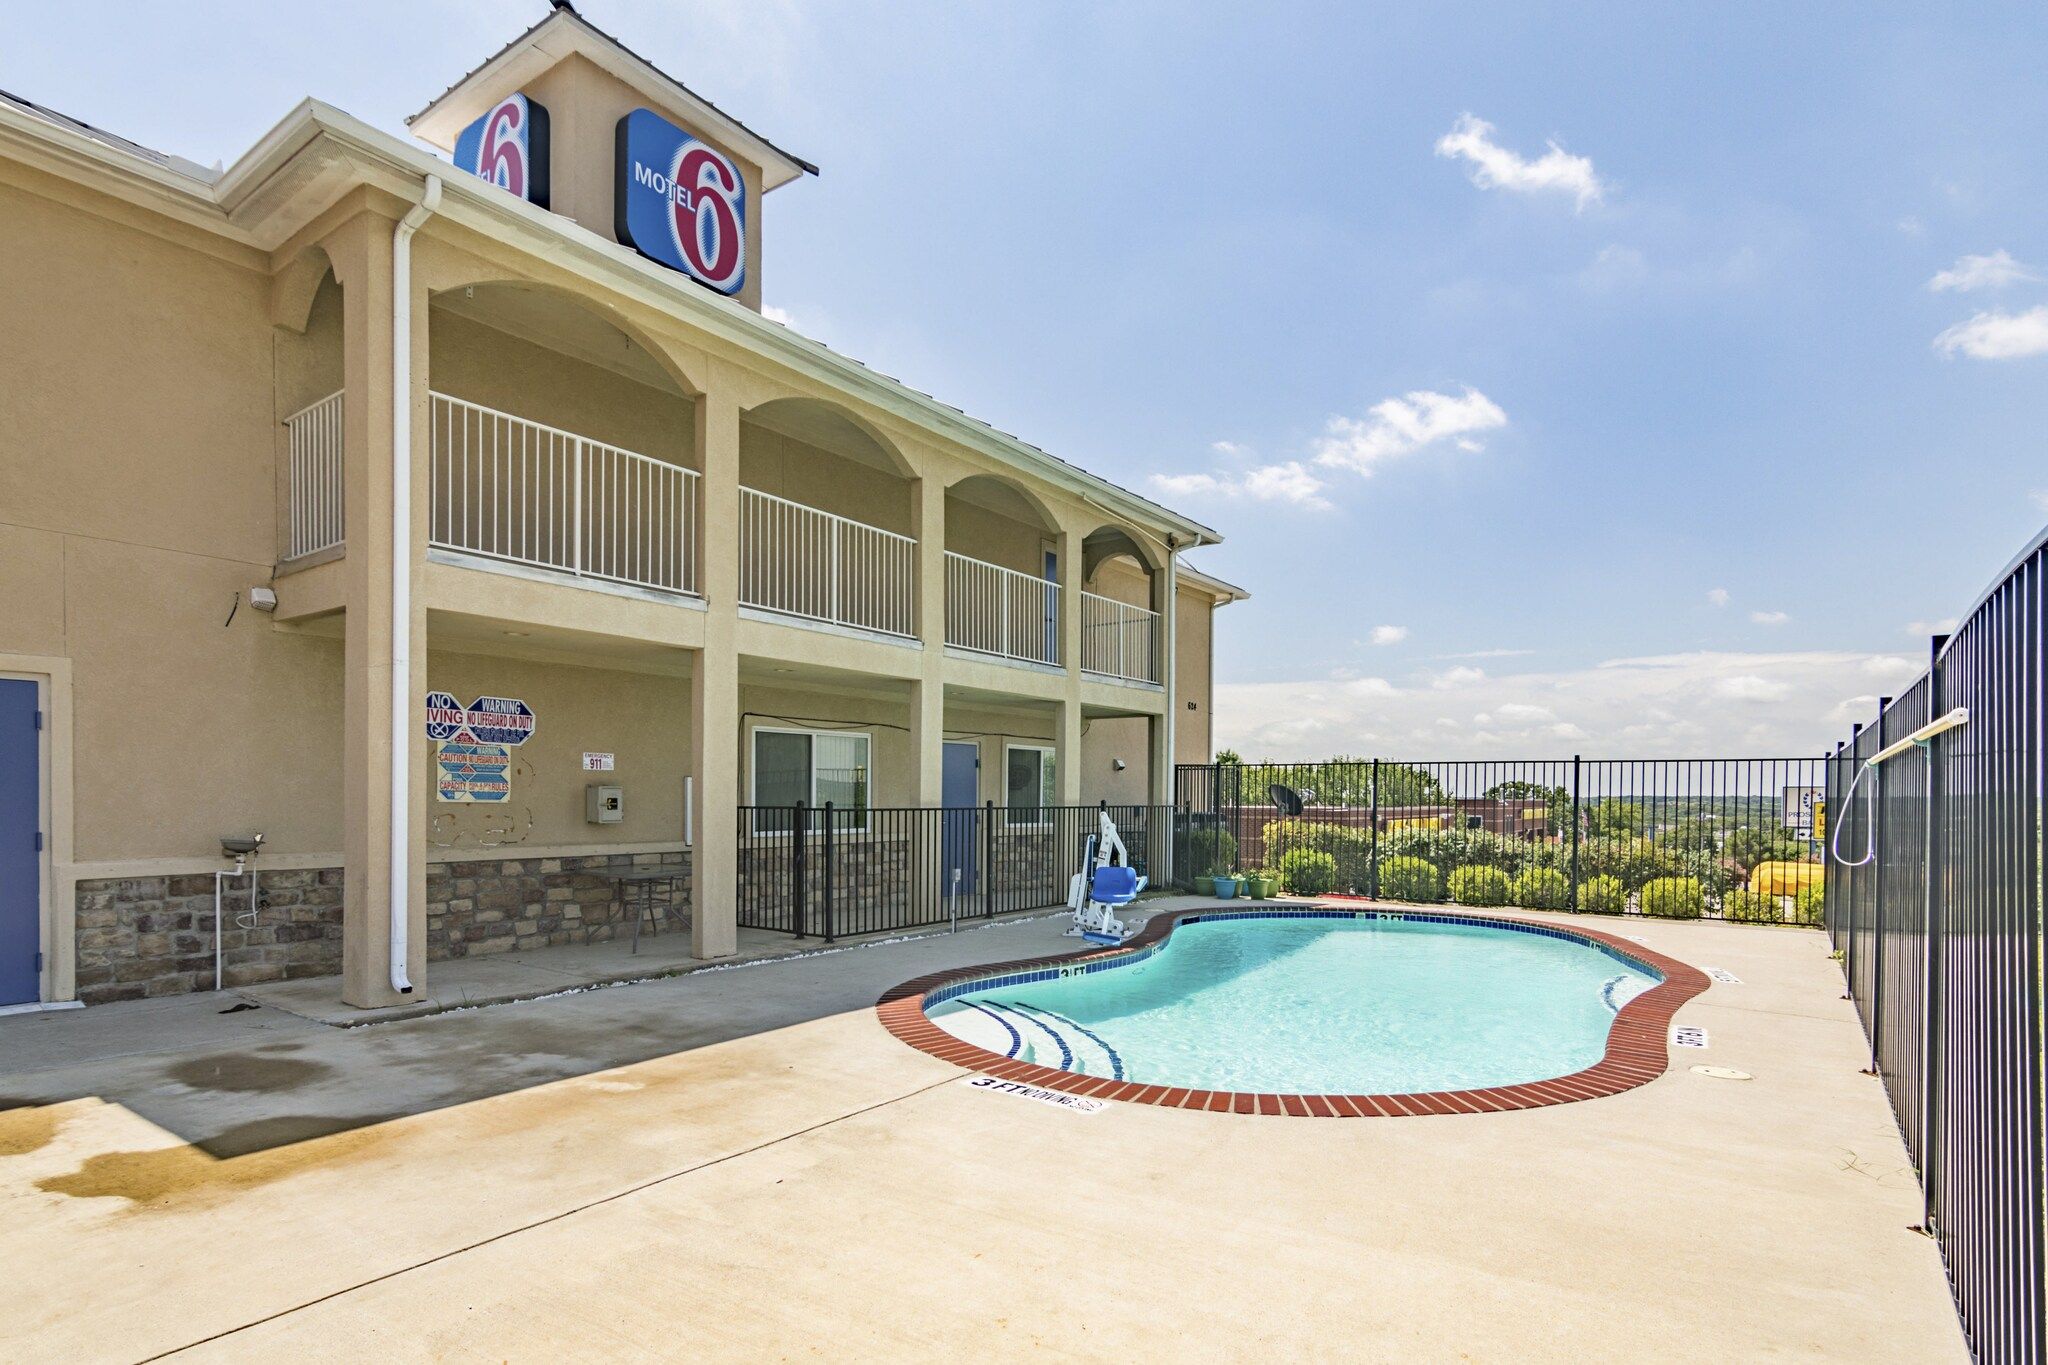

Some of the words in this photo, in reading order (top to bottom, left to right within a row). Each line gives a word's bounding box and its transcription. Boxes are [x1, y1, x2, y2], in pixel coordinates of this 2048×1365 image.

[481, 103, 524, 198] 6
[635, 161, 697, 213] MOTEL
[674, 148, 739, 282] 6
[431, 694, 451, 709] NO
[482, 698, 521, 715] WARNING
[427, 708, 464, 724] IVING
[467, 712, 476, 725] NO
[477, 713, 508, 727] LIFEGUARD
[509, 715, 518, 728] ON
[518, 716, 533, 730] DUTY
[440, 753, 467, 763] CAUTION
[589, 758, 602, 770] 911
[440, 781, 466, 791] CAPACITY
[971, 1078, 997, 1087] 3
[1034, 1091, 1077, 1105] DIVING
